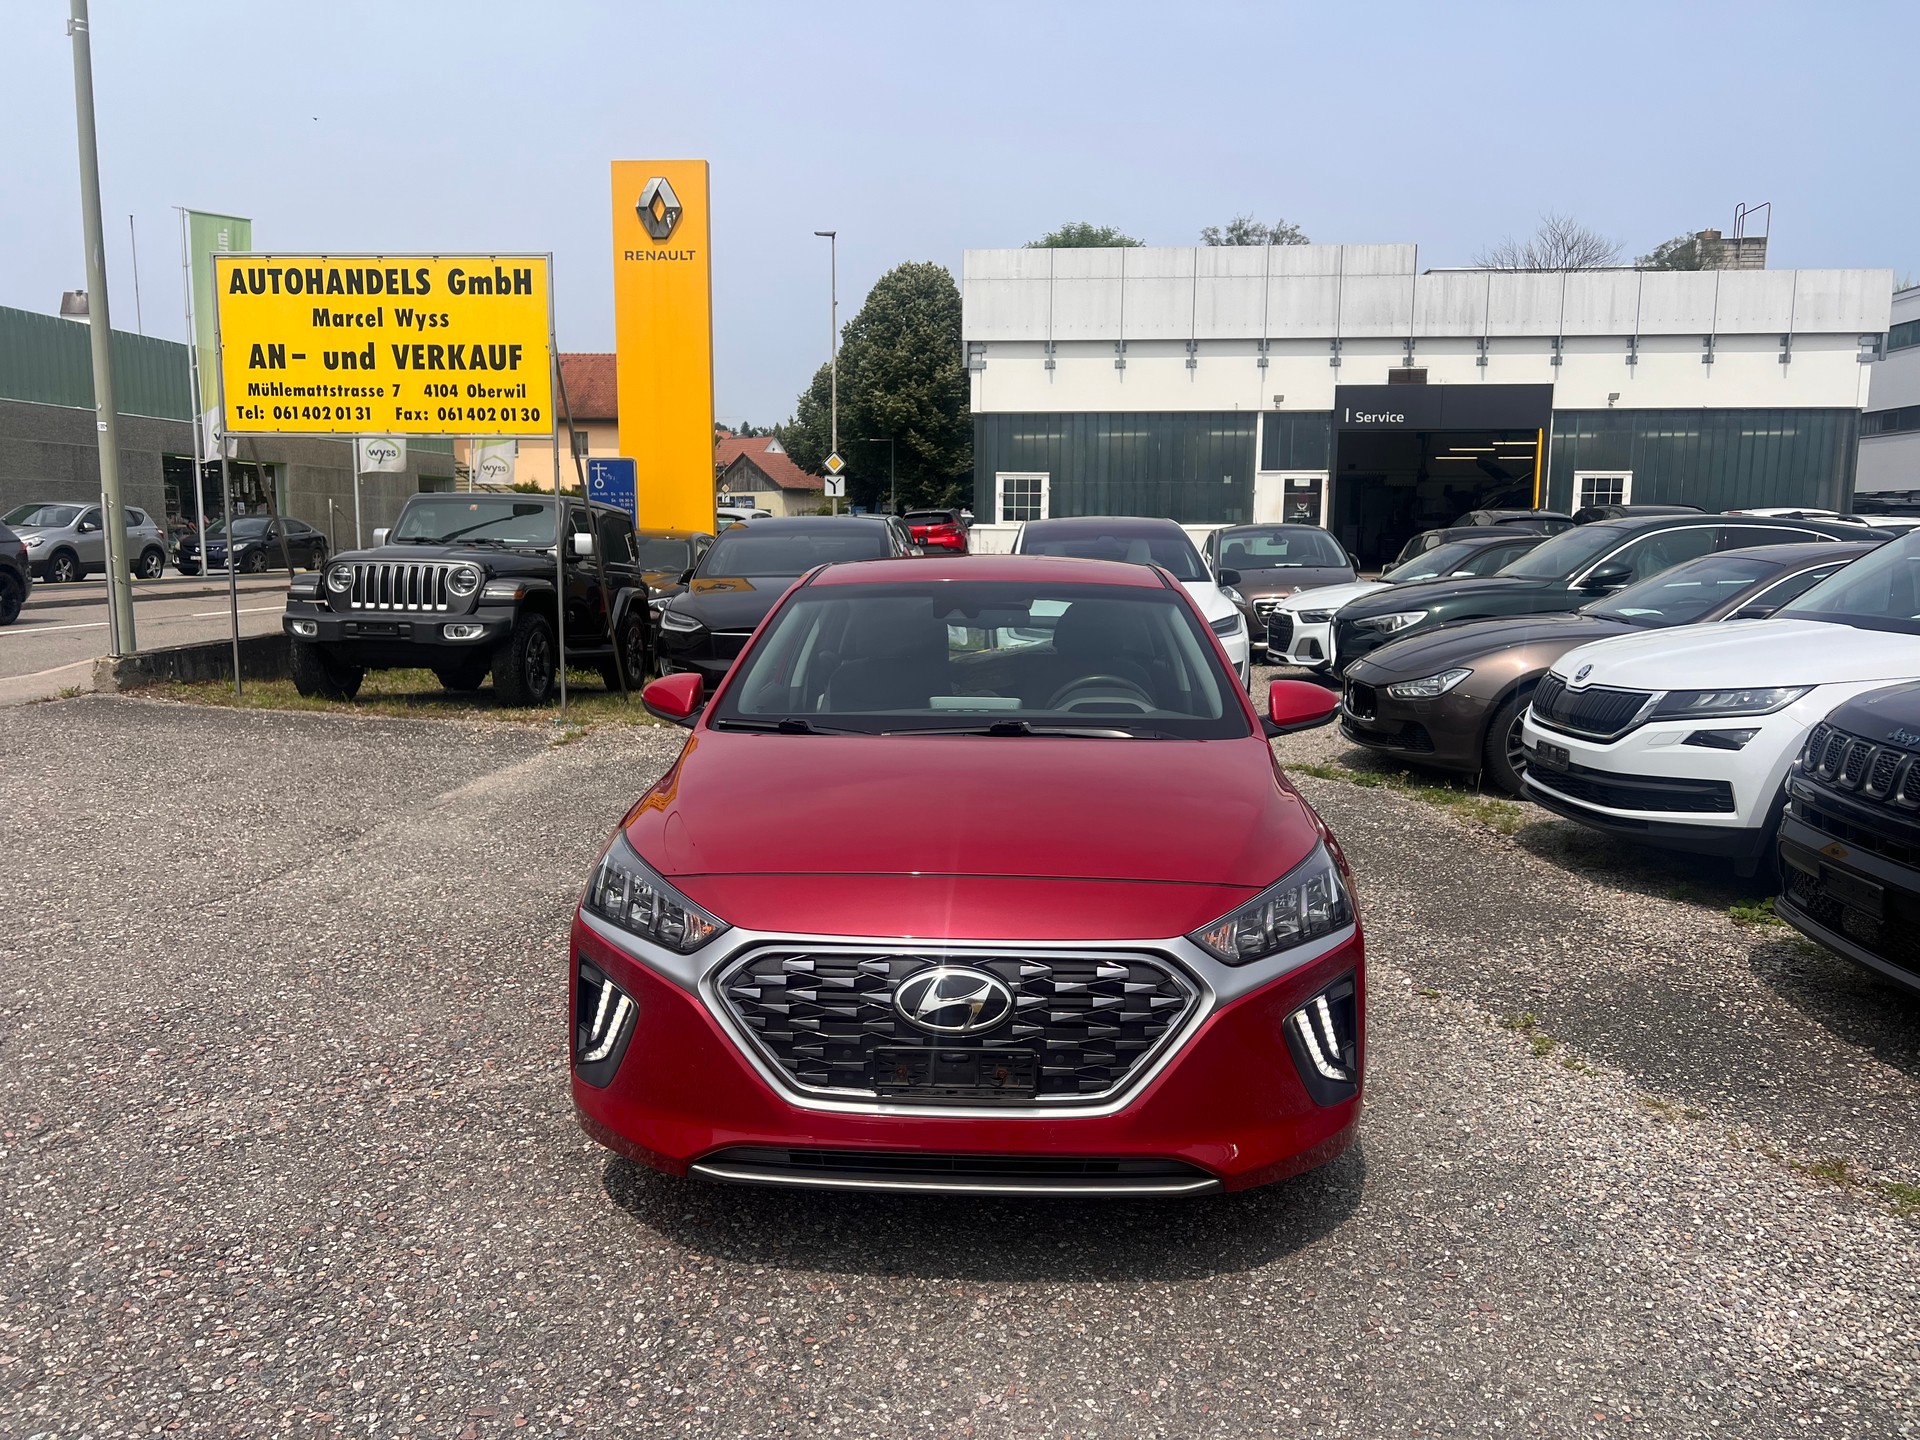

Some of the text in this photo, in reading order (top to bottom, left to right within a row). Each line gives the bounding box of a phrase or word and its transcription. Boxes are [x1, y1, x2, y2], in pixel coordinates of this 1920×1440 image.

[624, 250, 696, 261] RENAULT
[229, 266, 532, 296] AUTOHANDELS GmbH
[312, 306, 450, 332] Marcel Wyss
[248, 341, 522, 371] AN- und VERKAUF
[248, 382, 526, 398] Mühlemattstrasse 7 4104 Oberwil
[236, 405, 265, 420] Tel:
[395, 407, 429, 421] Fax:
[1355, 411, 1405, 423] Service
[368, 449, 397, 465] wyss
[482, 464, 507, 478] wyss
[1886, 727, 1920, 747] Jeep
